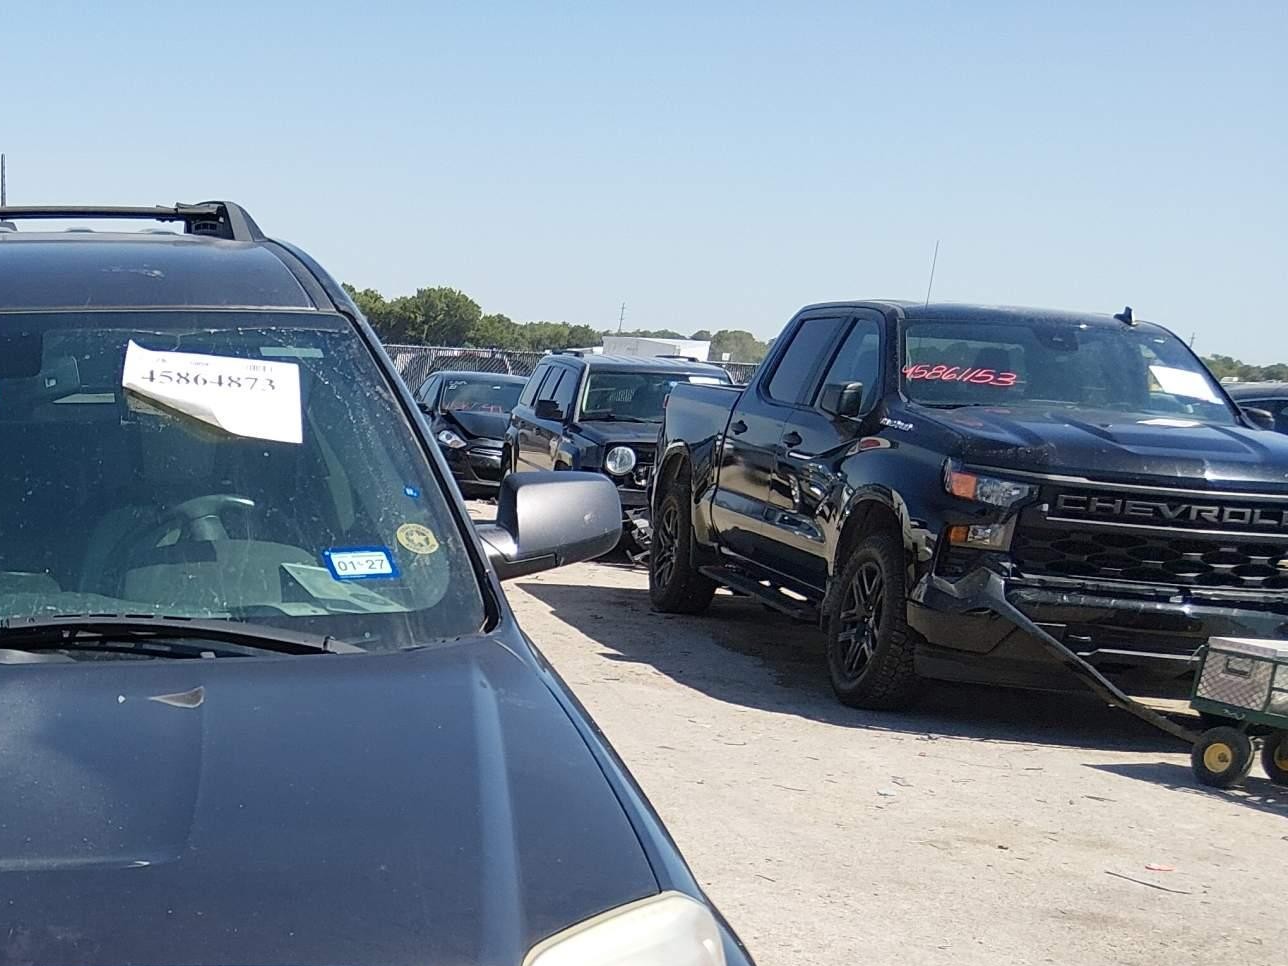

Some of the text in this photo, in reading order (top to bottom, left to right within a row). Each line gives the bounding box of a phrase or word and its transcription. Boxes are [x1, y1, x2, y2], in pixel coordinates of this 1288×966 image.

[141, 369, 276, 391] 45864873
[902, 364, 1018, 386] 45861153
[1058, 494, 1288, 527] CHEVROL
